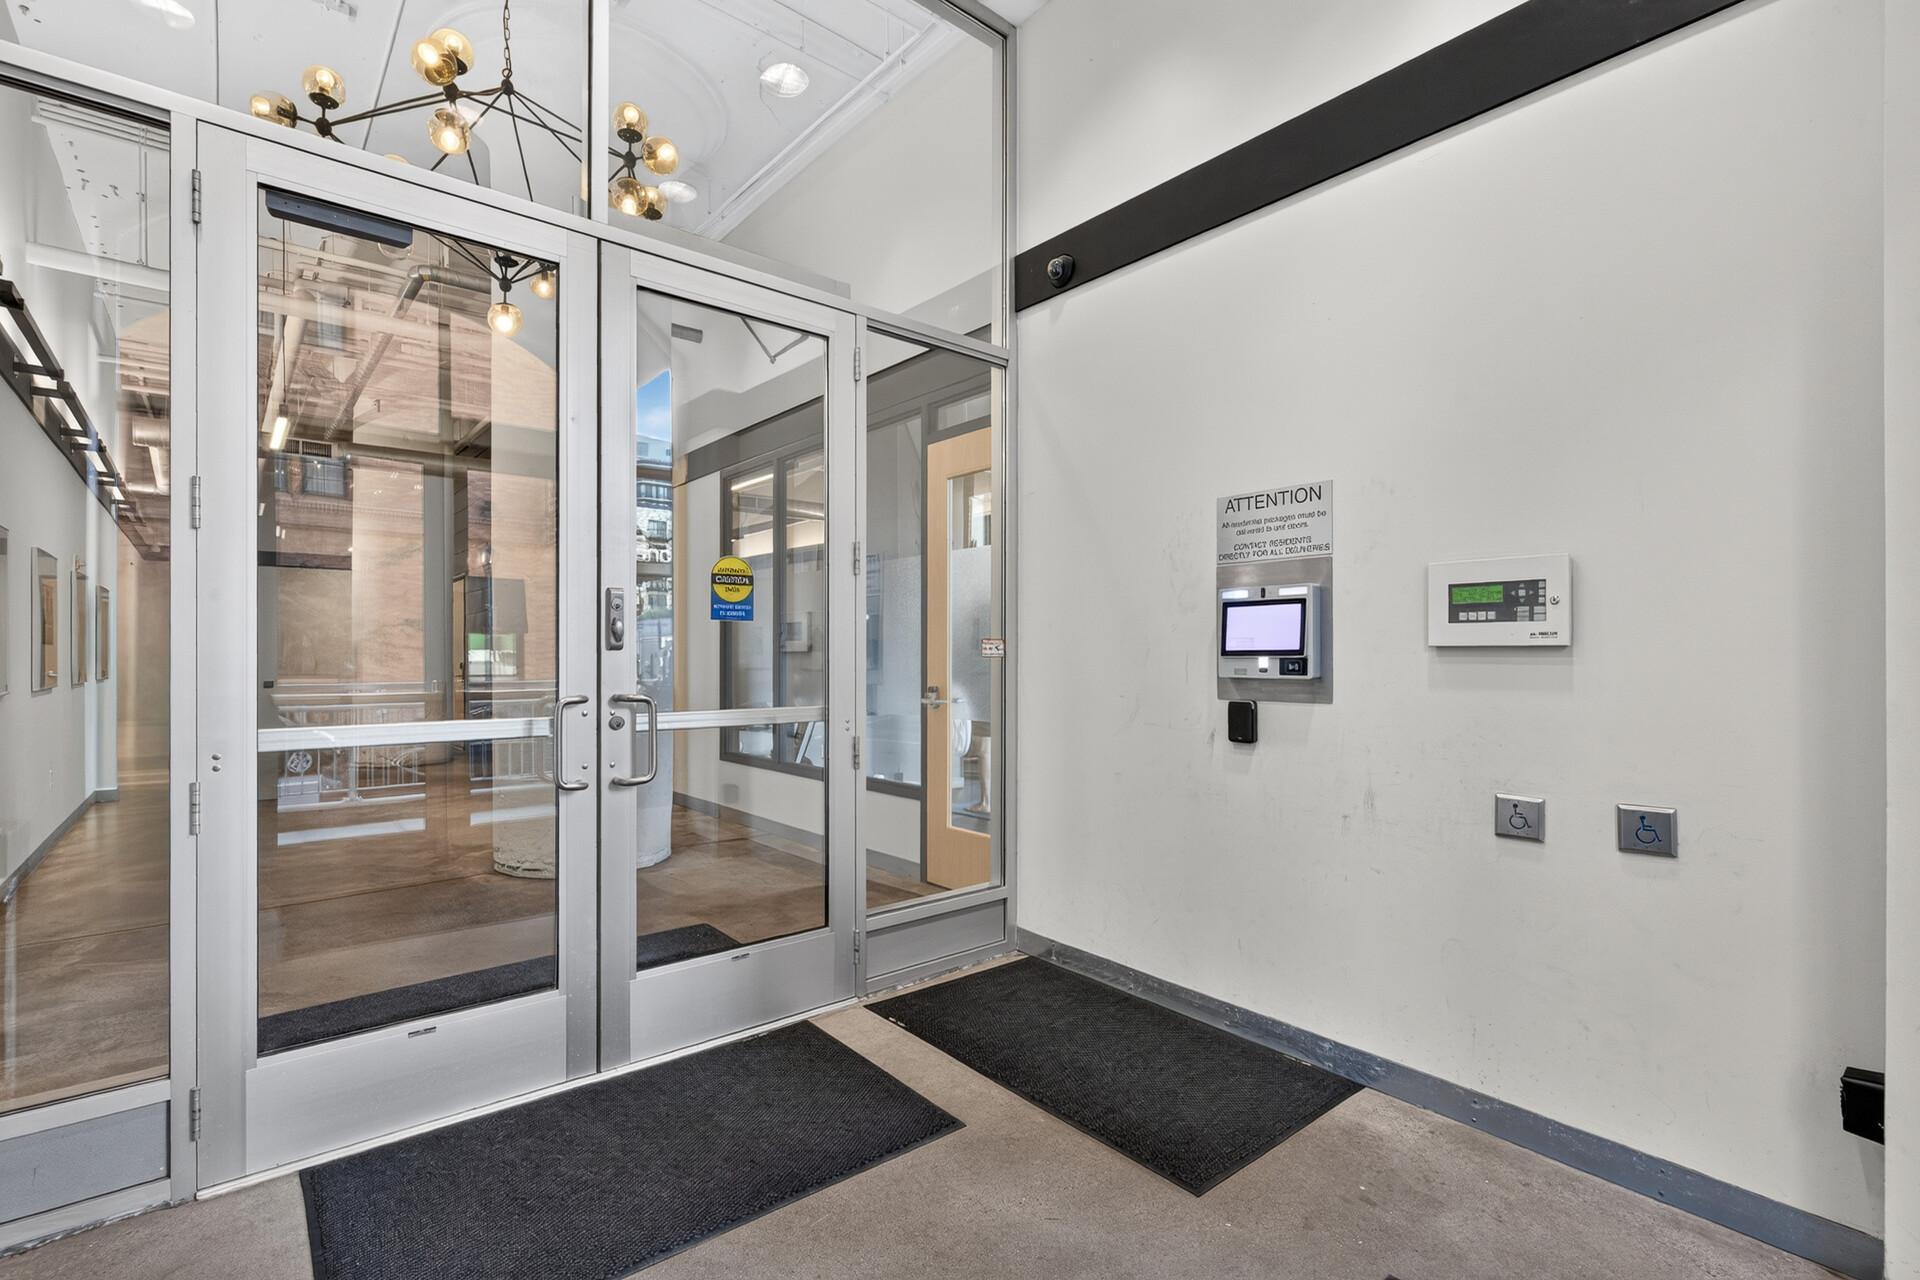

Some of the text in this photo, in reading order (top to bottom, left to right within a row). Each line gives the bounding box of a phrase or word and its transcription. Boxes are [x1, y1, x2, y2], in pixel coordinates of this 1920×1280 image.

[1225, 485, 1322, 514] ATTENTION
[1264, 515, 1295, 524] packages
[1298, 511, 1315, 519] must
[1234, 536, 1312, 551] CONTACT RESIDENTS
[1219, 549, 1250, 561] DIRECTLY
[1253, 549, 1268, 557] FOR
[1285, 543, 1330, 555] DELIVERIES
